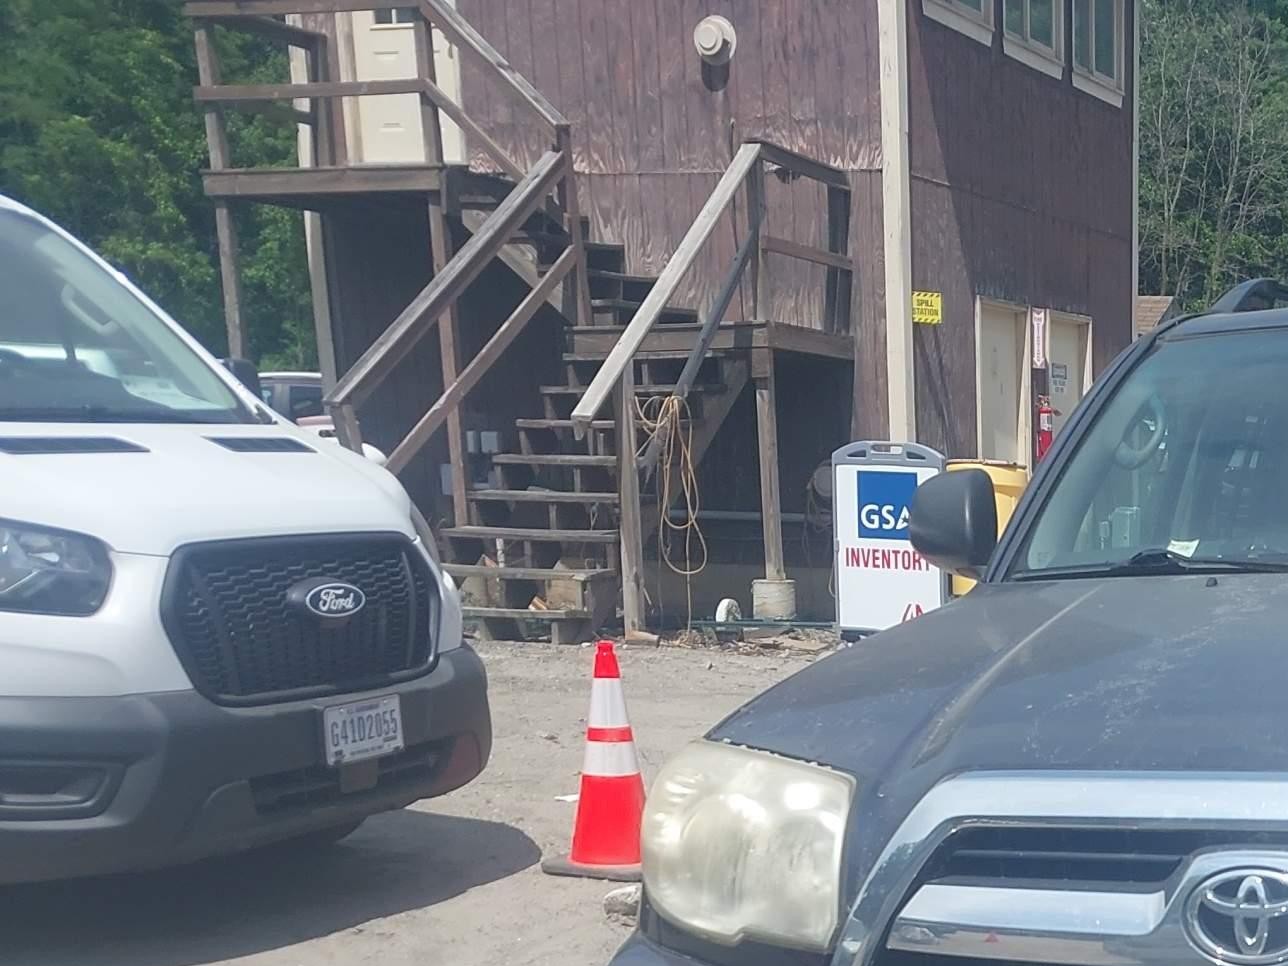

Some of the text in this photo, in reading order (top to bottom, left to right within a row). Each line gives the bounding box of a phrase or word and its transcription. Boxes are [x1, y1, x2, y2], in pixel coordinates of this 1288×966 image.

[916, 299, 934, 308] SPILL
[912, 307, 939, 317] STATION
[319, 588, 355, 612] Ford
